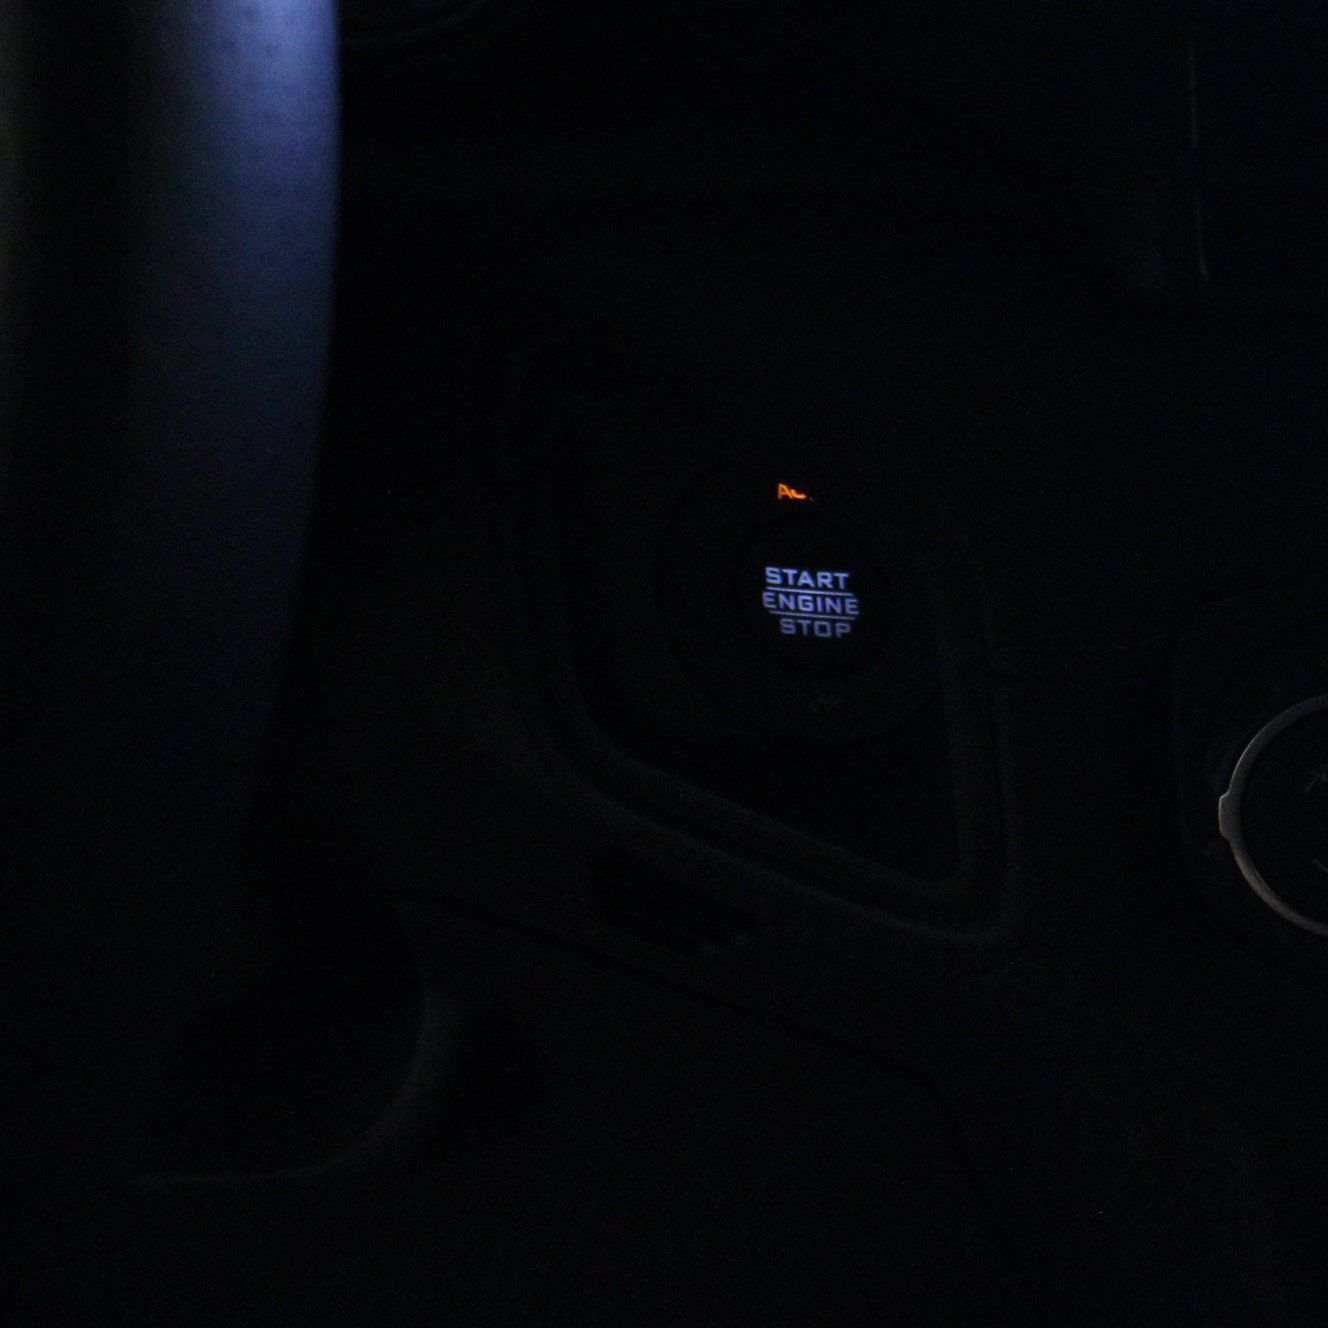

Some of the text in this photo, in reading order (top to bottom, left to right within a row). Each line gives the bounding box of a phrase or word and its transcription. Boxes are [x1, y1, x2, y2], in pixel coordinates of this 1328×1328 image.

[765, 566, 850, 589] START
[761, 591, 860, 615] ENGINE
[779, 618, 852, 638] STOP
